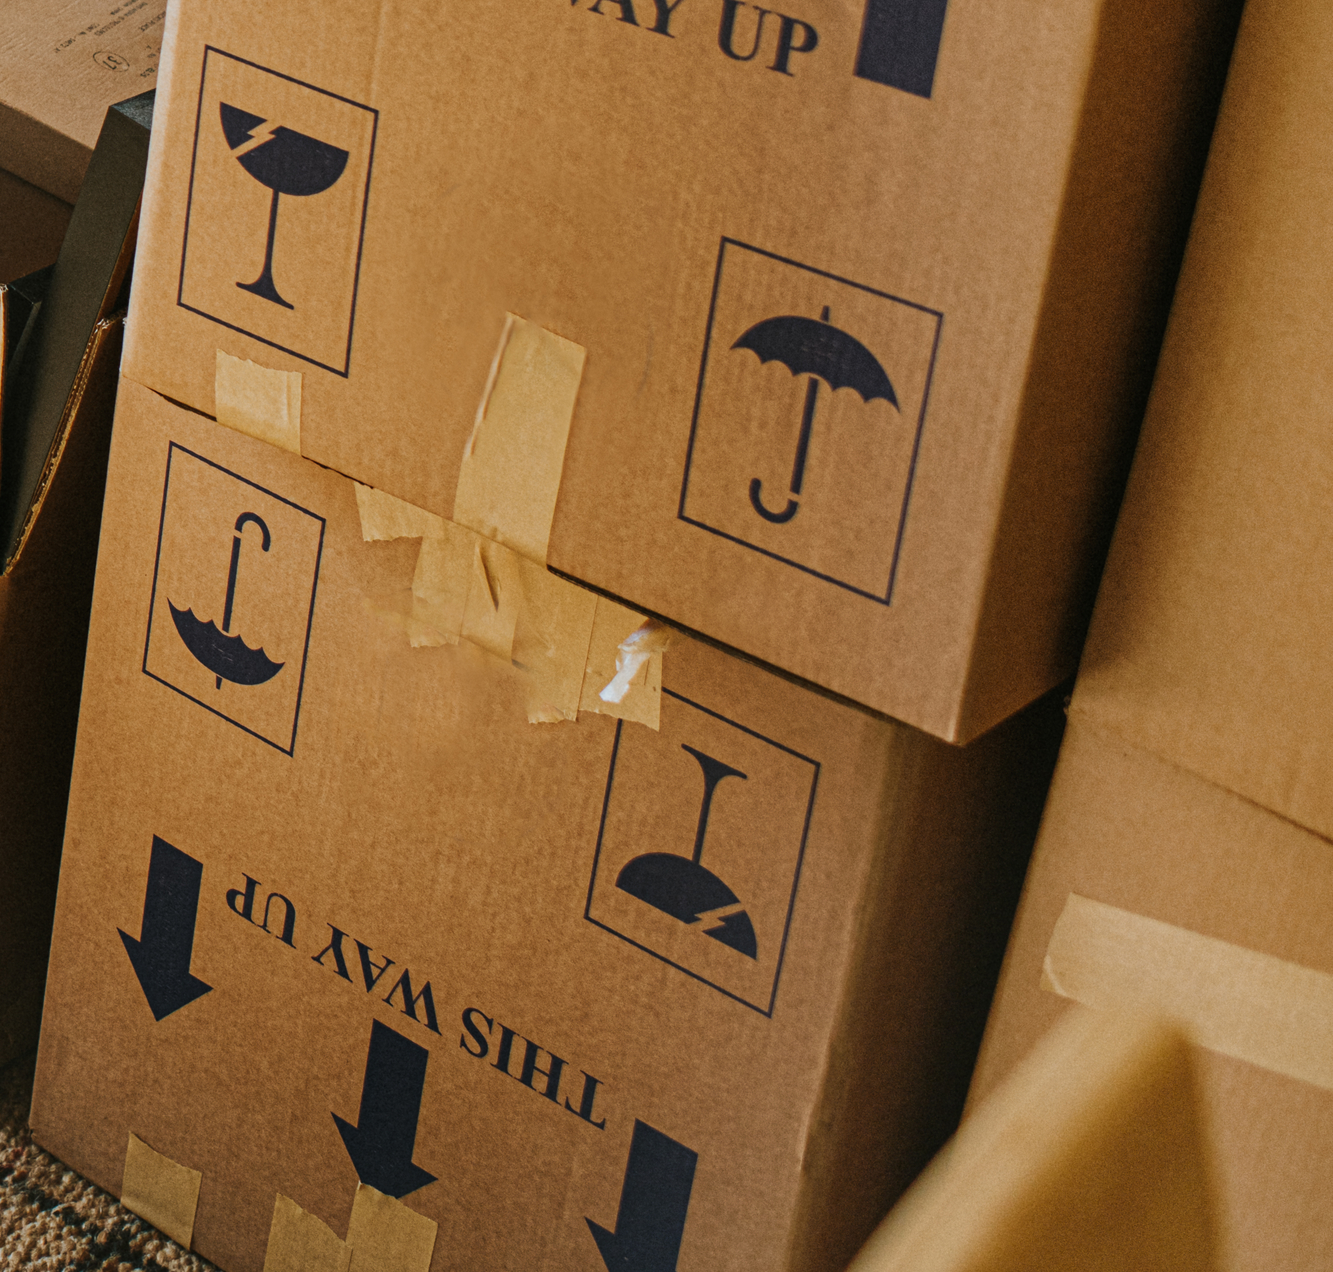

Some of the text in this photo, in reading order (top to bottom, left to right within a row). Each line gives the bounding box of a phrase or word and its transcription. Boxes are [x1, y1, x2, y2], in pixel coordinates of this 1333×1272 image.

[101, 54, 123, 71] 37
[225, 872, 607, 1130] THIS WAY UP
